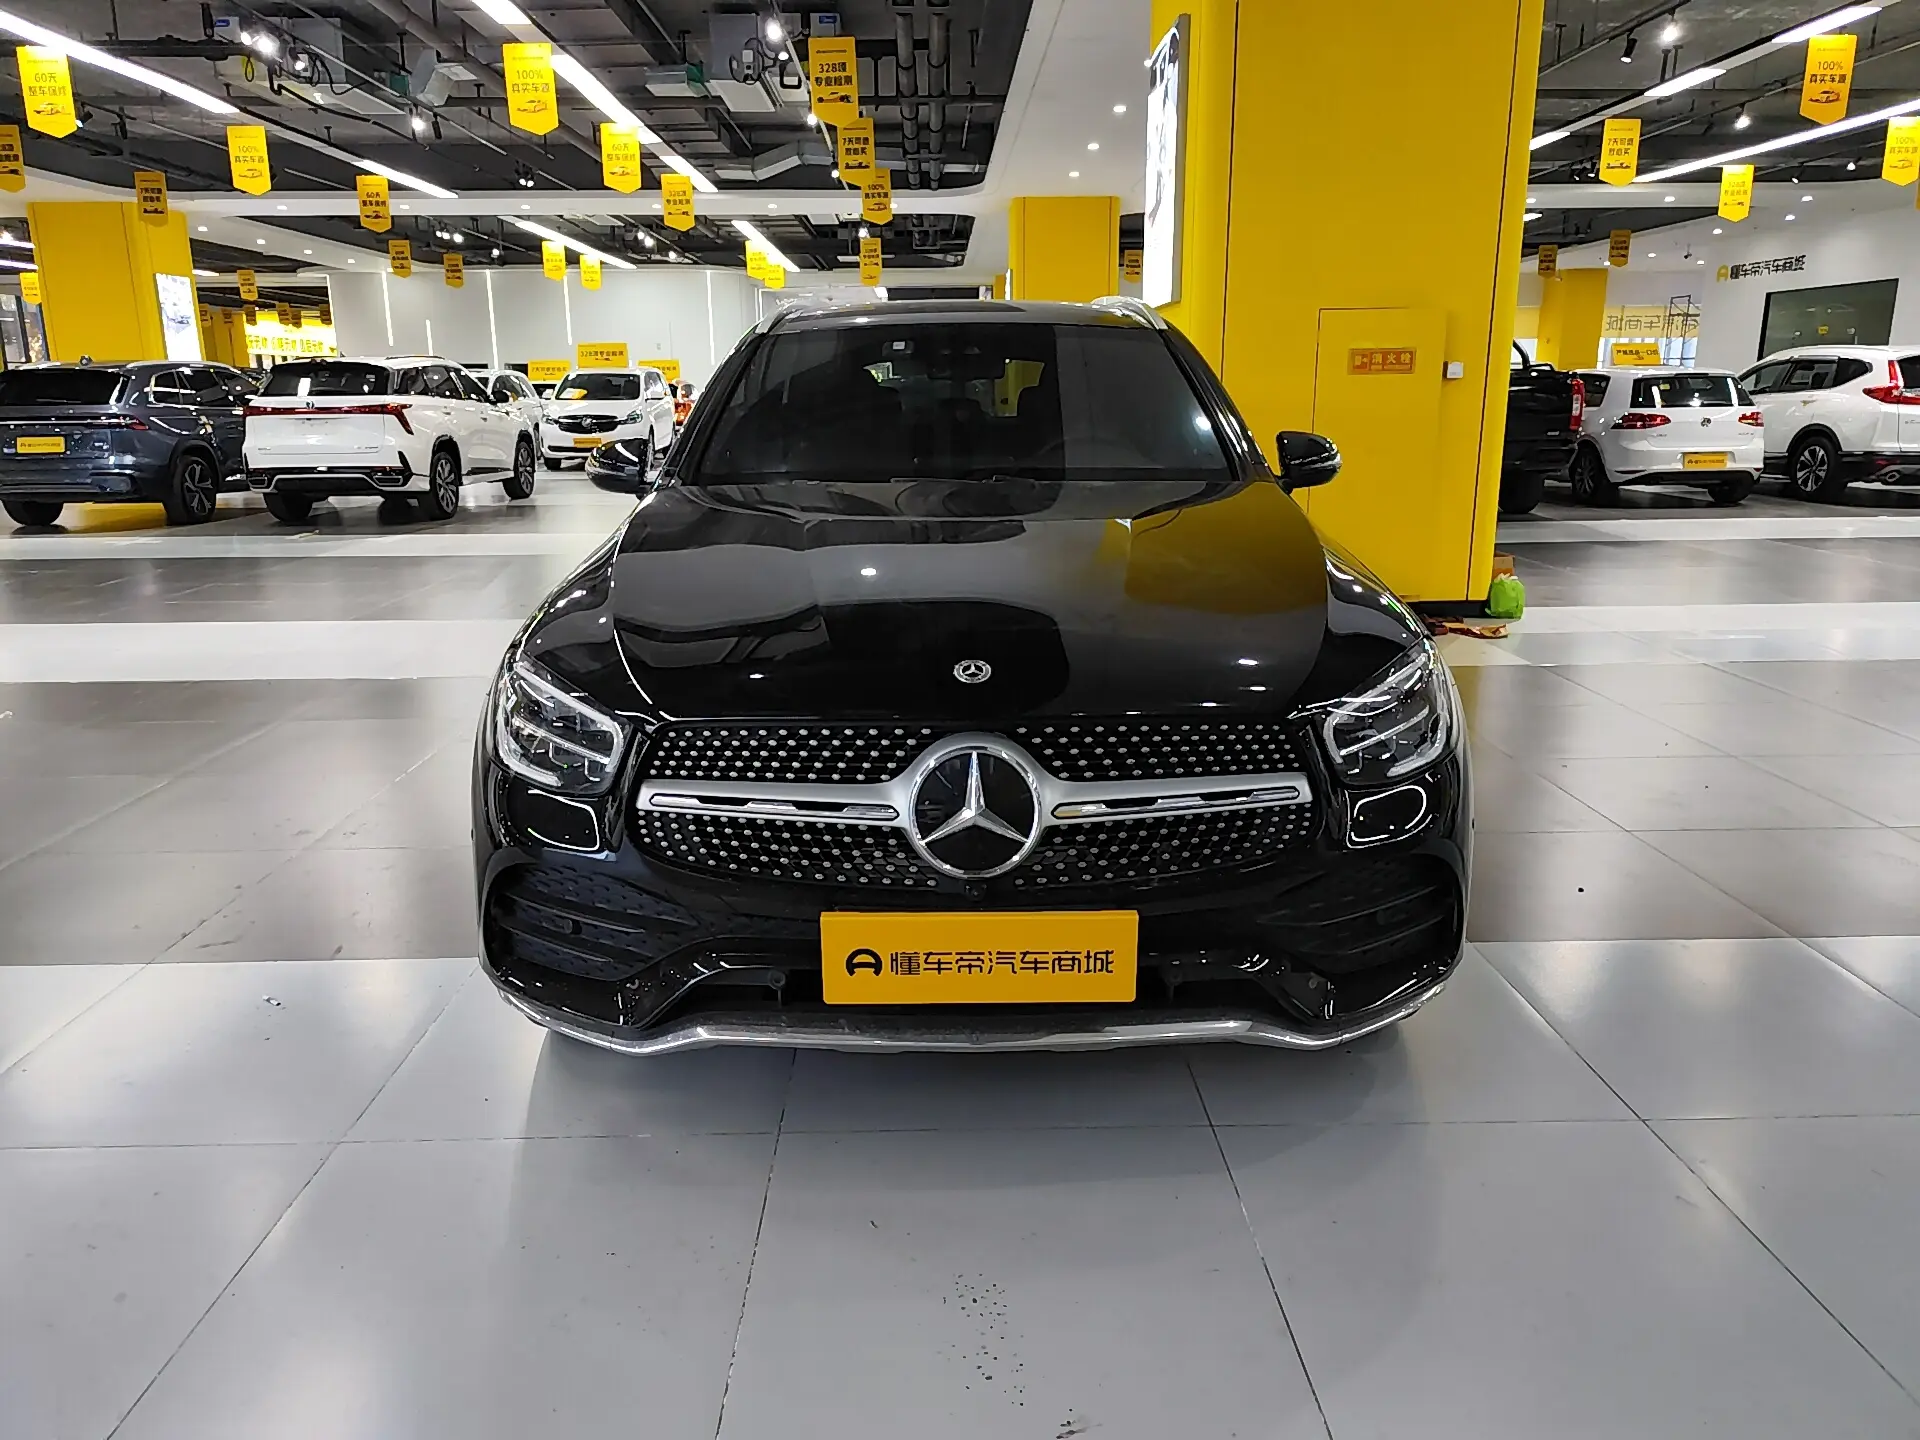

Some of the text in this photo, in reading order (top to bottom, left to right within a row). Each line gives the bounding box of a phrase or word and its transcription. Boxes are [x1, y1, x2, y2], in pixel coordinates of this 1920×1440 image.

[818, 61, 847, 73] 328项
[1817, 61, 1844, 70] 100%
[34, 73, 57, 84] 60天
[516, 69, 543, 79] 100%
[814, 75, 853, 87] 专业检测
[28, 85, 67, 97] 整车保修
[1895, 137, 1916, 145] 100%
[237, 145, 259, 154] 100%
[612, 143, 629, 151] 60天
[1372, 352, 1412, 364] 消火栓
[889, 949, 1116, 976] 懂车帝汽车商城
